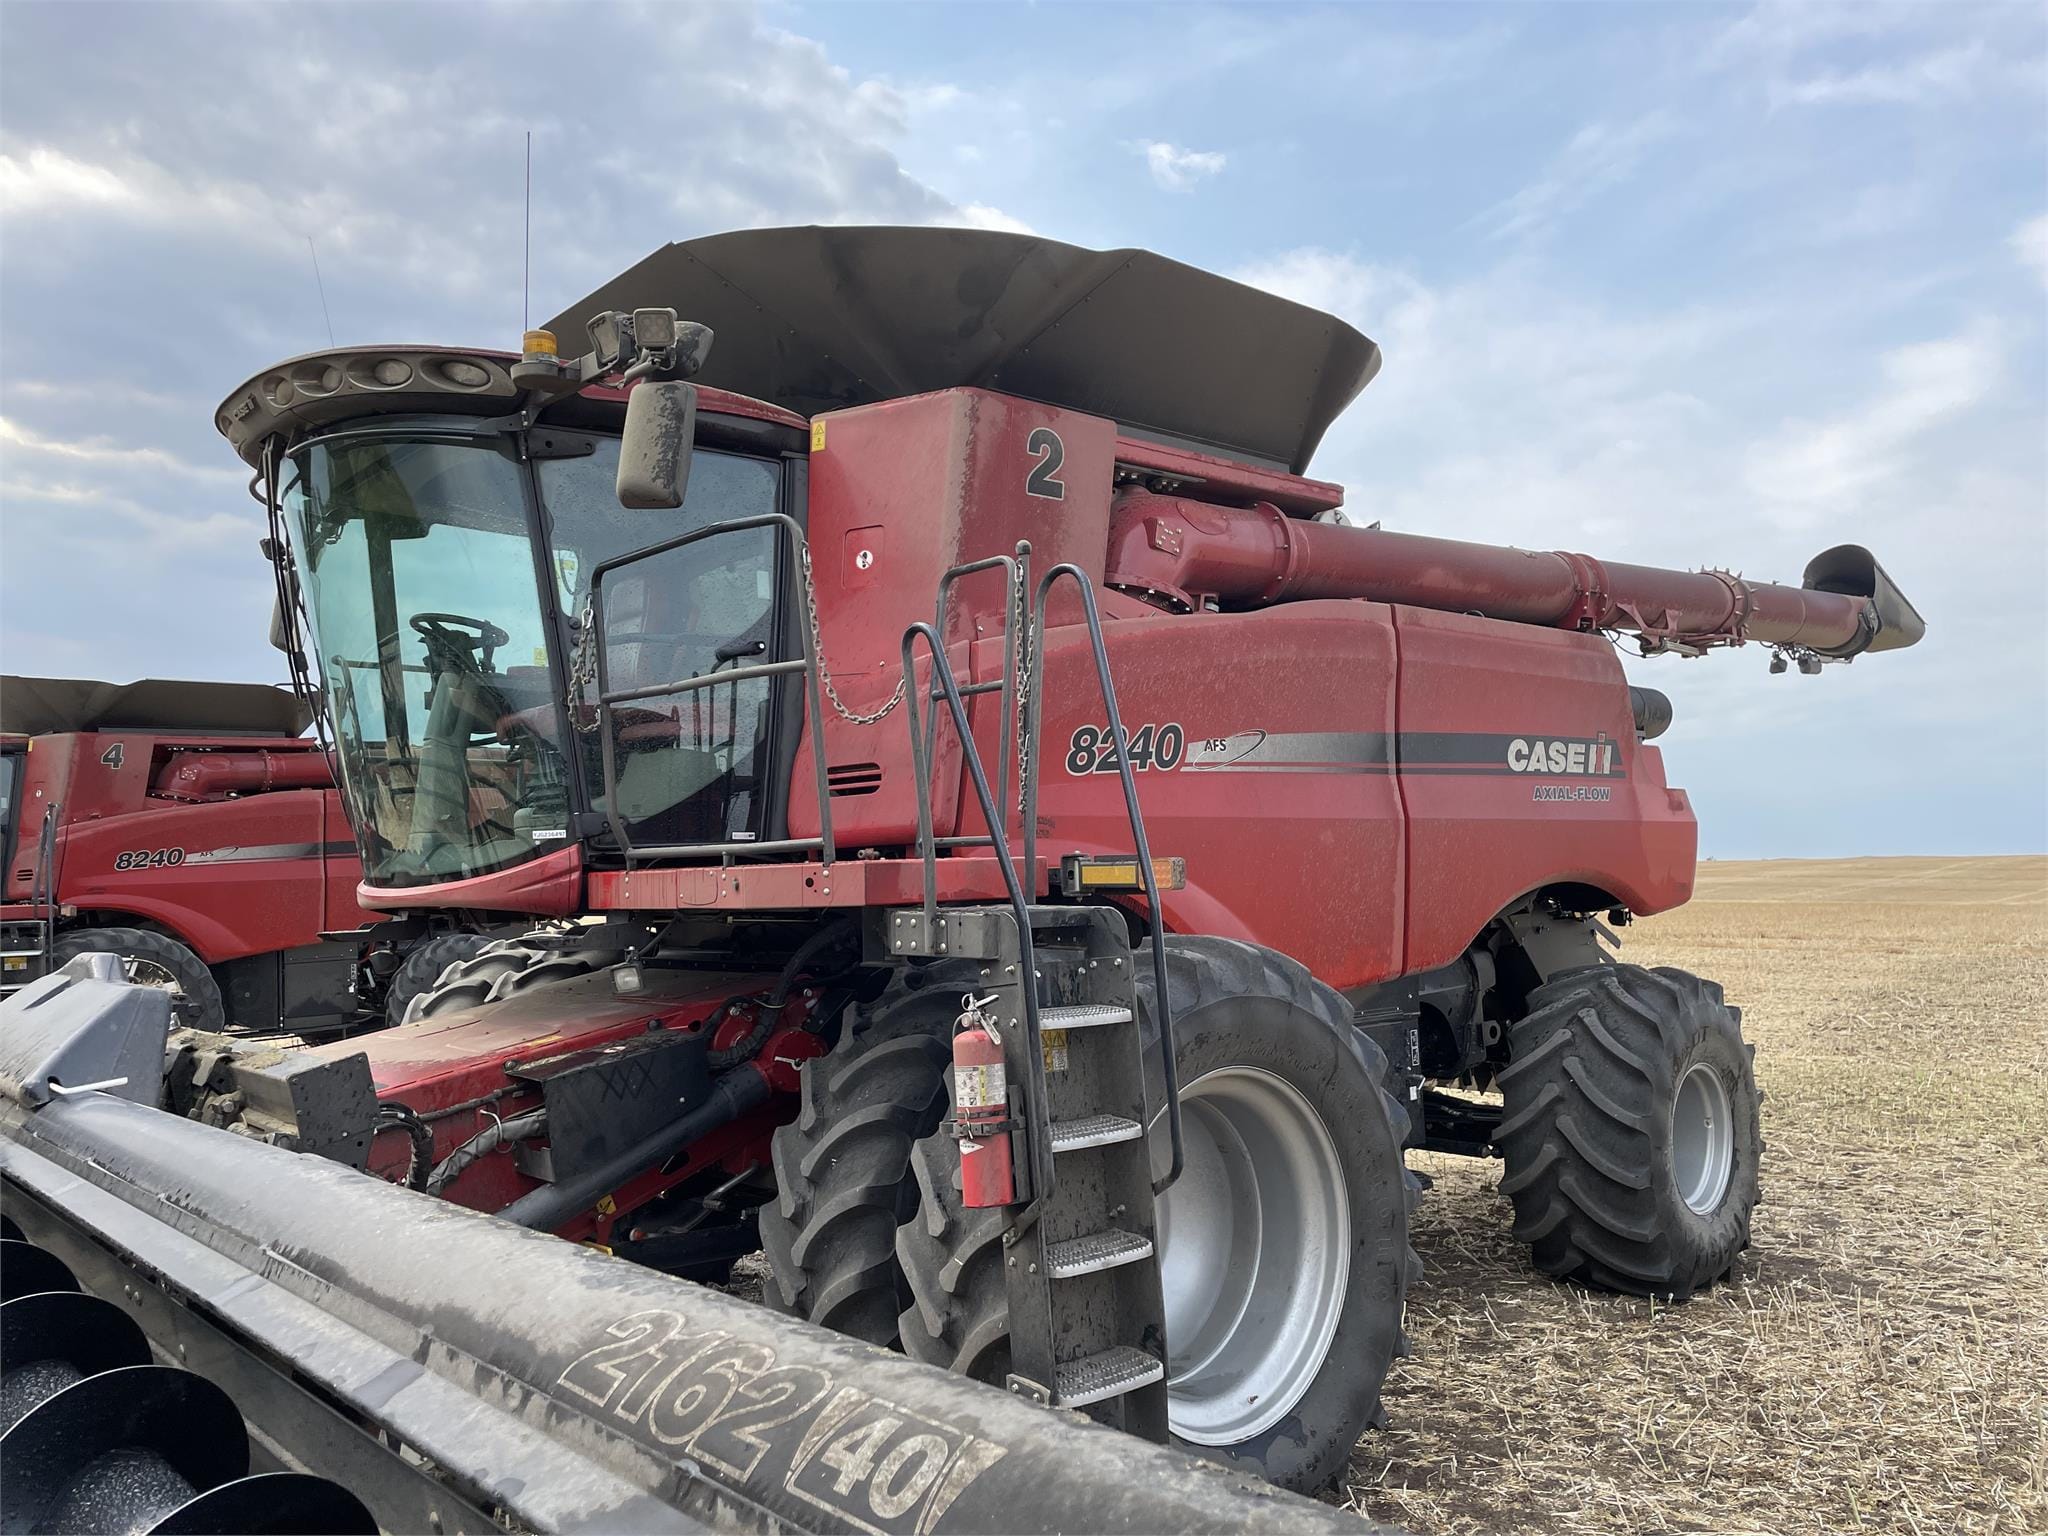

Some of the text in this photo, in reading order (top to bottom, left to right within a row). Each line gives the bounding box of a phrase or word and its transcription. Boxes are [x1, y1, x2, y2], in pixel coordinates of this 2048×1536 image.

[1026, 427, 1065, 501] 2
[100, 743, 125, 770] 4
[1065, 722, 1227, 777] 8240 AFS
[1507, 738, 1586, 774] CASE
[1533, 785, 1611, 802] AXIAL-FLOW
[114, 847, 185, 872] 8240
[556, 1308, 948, 1520] 2162 40
